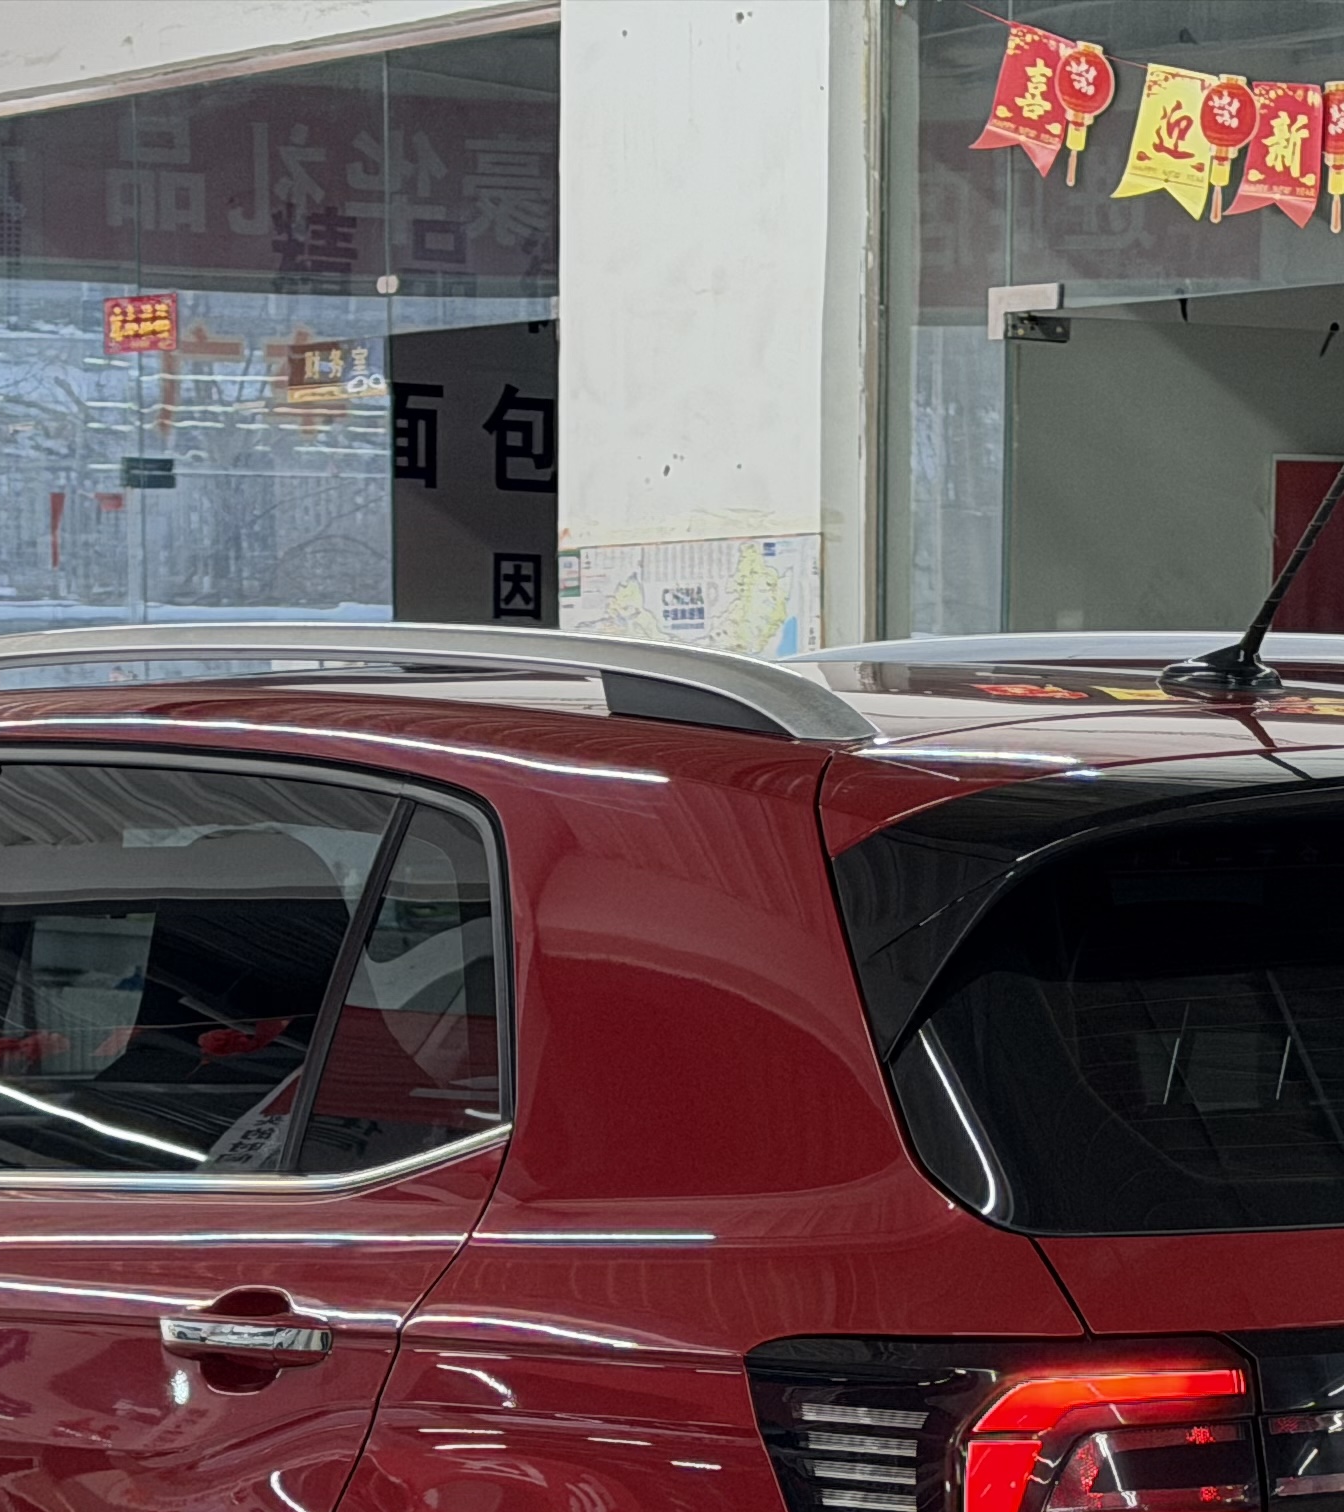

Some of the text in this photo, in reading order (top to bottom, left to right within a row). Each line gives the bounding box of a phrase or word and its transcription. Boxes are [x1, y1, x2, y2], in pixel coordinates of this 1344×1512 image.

[1014, 58, 1053, 120] 喜
[1152, 100, 1196, 160] 迎
[1261, 110, 1310, 178] 新
[303, 347, 370, 380] 财务室
